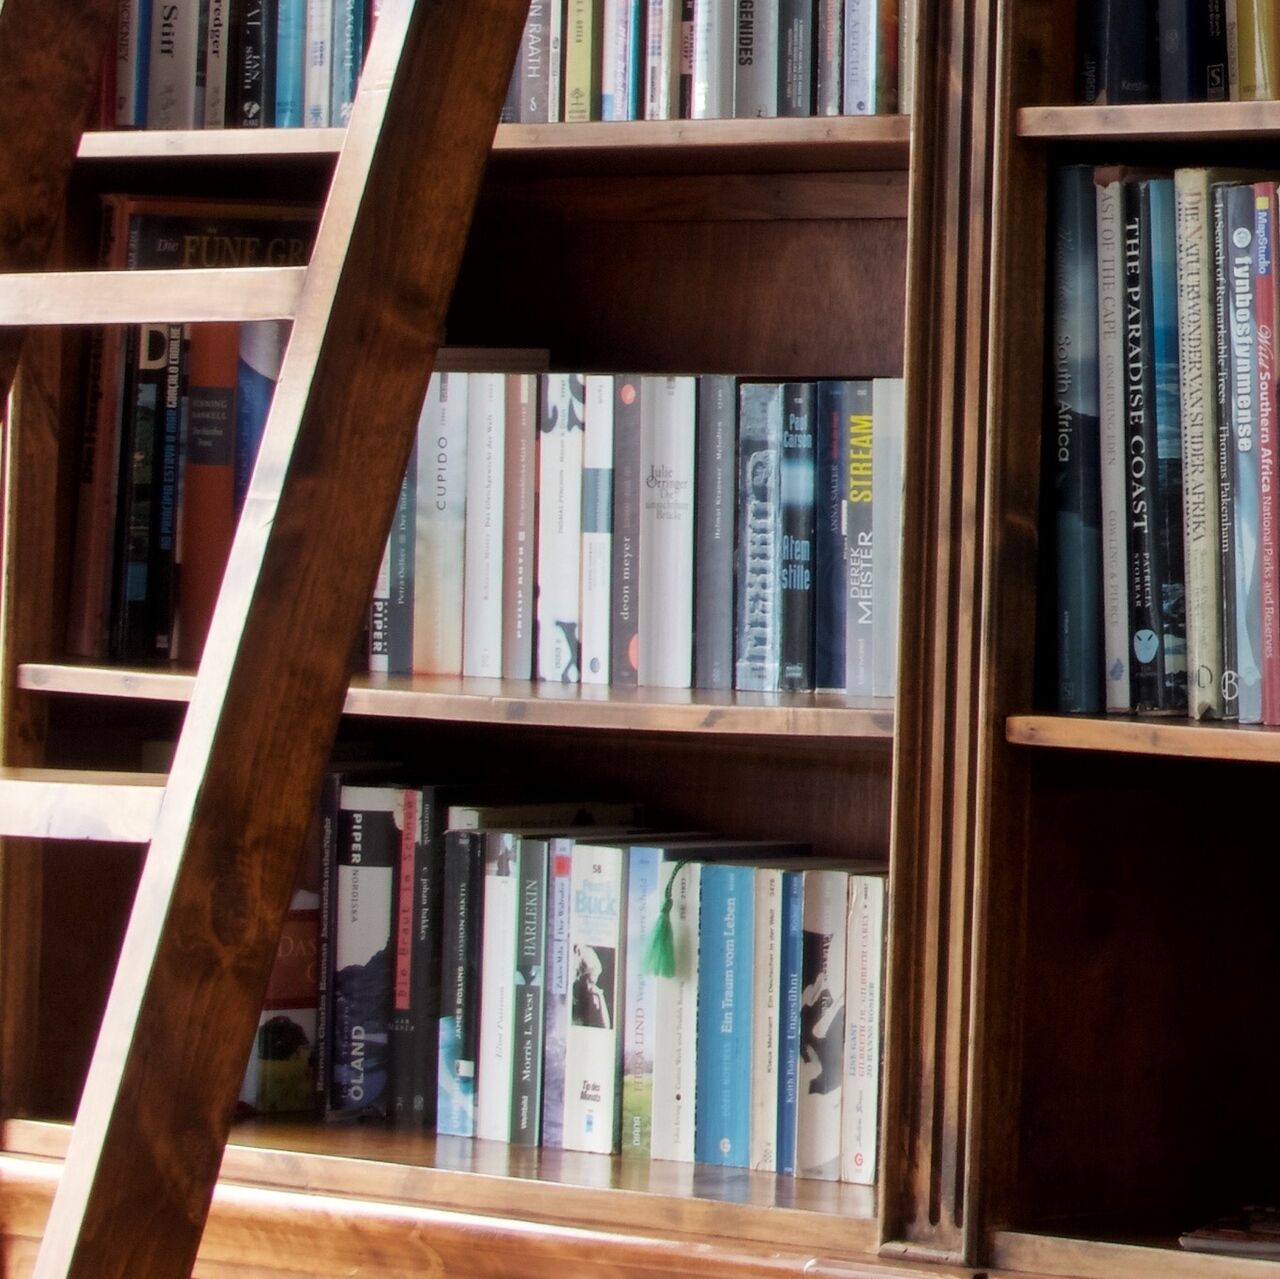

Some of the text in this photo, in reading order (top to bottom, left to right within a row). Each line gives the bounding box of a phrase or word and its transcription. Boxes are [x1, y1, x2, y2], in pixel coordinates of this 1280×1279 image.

[161, 6, 179, 59] Stiff
[528, 23, 541, 78] RAATH
[1127, 285, 1149, 534] PARADISE COAST
[437, 437, 448, 511] CUPIDO
[850, 415, 873, 503] STREAM
[620, 536, 633, 620] deon meyer
[851, 547, 861, 598] DEREK
[859, 532, 872, 624] MEISTER
[352, 813, 363, 864] PIPER
[524, 880, 538, 957] HARLEKIN
[719, 897, 735, 1033] Ein Traum vom Leben
[786, 973, 799, 1040] Ungesühnt
[346, 1026, 365, 1100] ÖLAND
